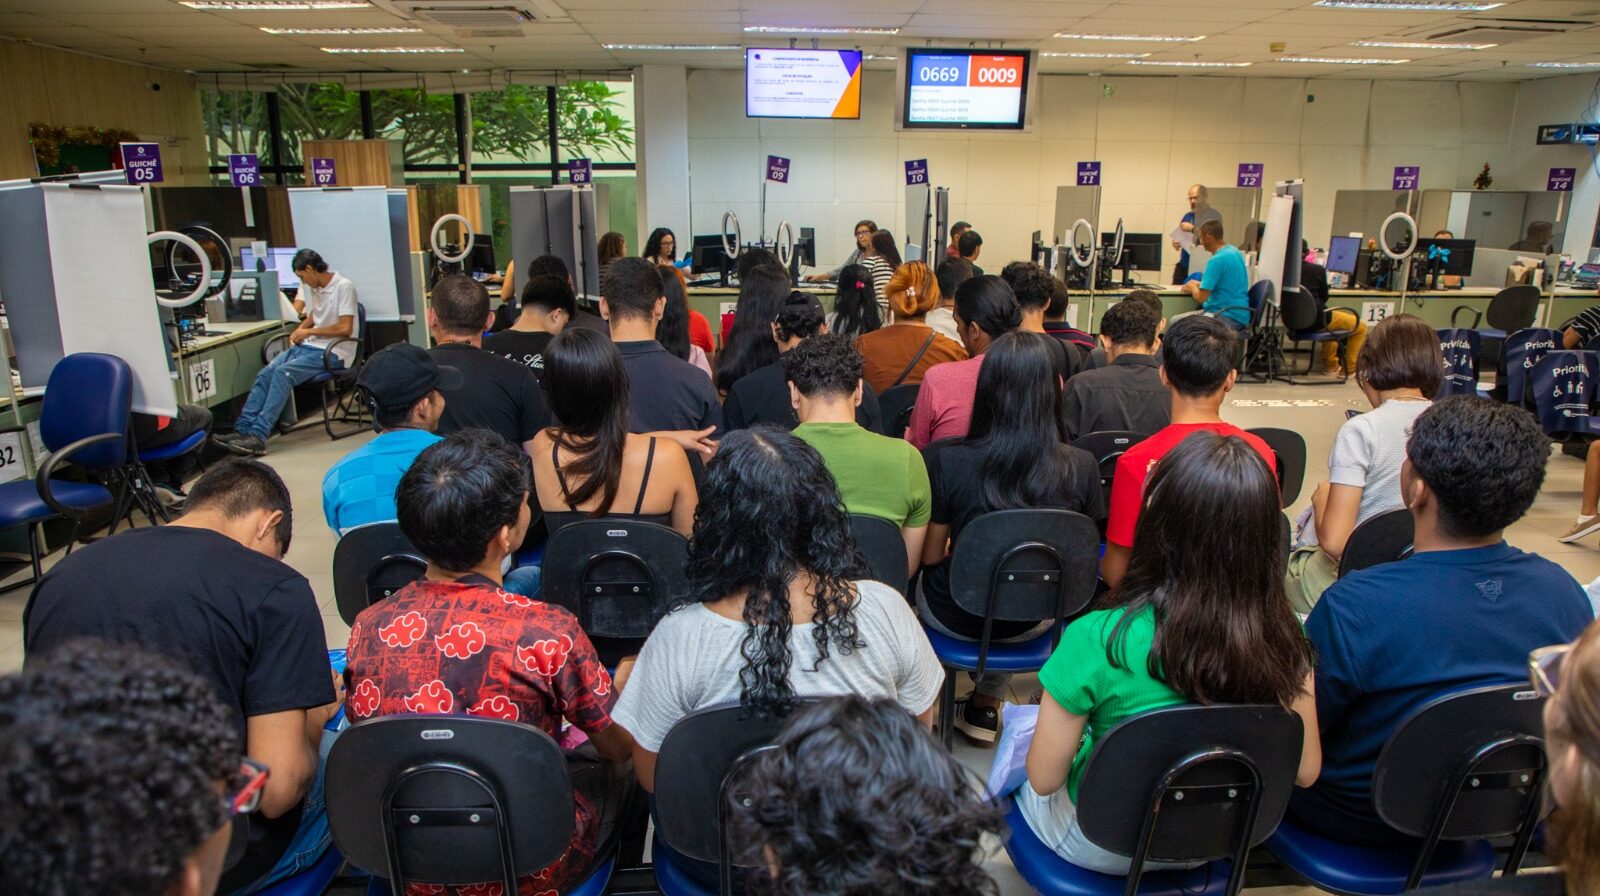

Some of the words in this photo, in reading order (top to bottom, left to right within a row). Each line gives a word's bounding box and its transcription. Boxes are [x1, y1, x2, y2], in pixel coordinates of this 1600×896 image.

[920, 67, 959, 82] 0669
[978, 68, 1017, 83] 0009
[129, 158, 157, 168] GUICHÊ
[135, 168, 154, 180] 05
[234, 166, 256, 174] GUICHÊ
[239, 174, 255, 184] 06
[318, 174, 331, 183] 07
[574, 173, 585, 182] 08
[772, 172, 784, 180] 09
[911, 174, 923, 183] 10
[1082, 176, 1094, 184] 11
[1242, 177, 1257, 186] 12
[1398, 180, 1413, 188] 13
[1552, 182, 1568, 190] 14
[1368, 308, 1386, 322] 13
[196, 371, 210, 393] 06
